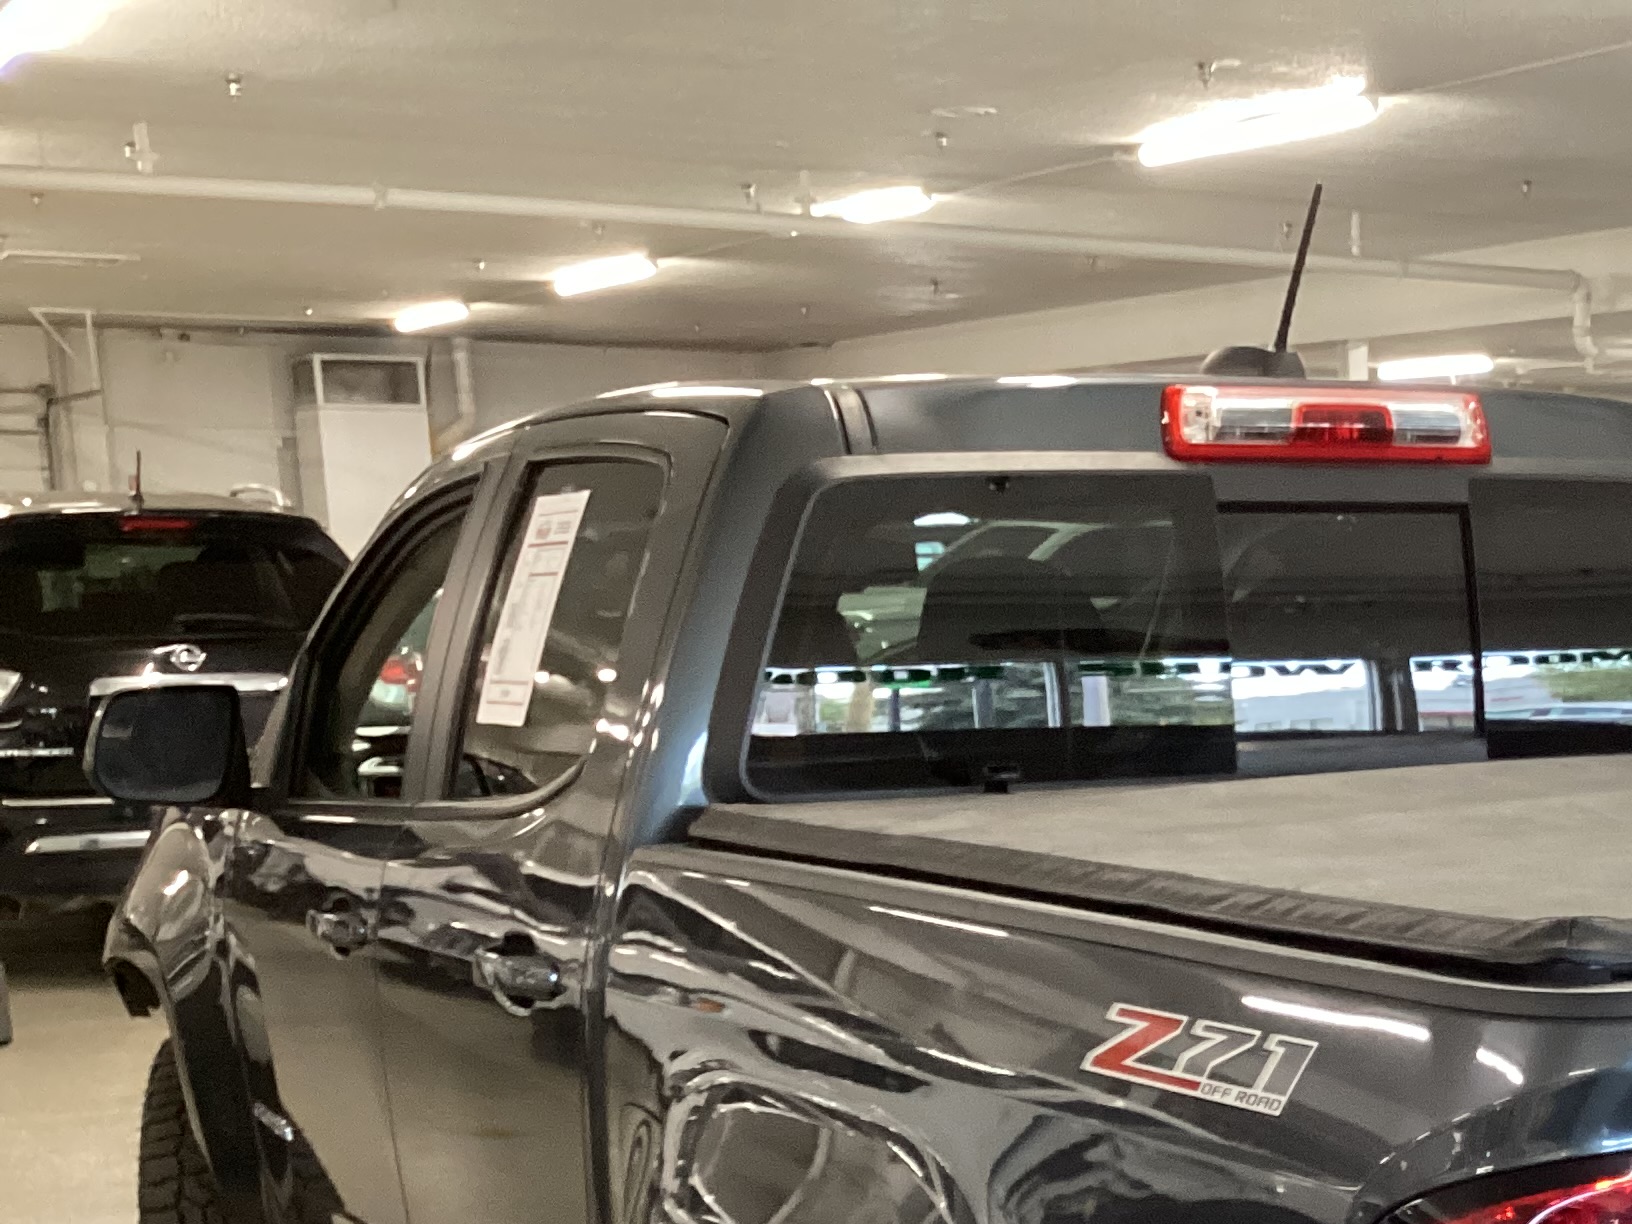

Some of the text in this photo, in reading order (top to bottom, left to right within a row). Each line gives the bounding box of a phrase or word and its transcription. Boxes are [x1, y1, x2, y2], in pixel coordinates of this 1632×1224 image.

[1080, 1002, 1319, 1100] Z71
[1200, 1083, 1283, 1112] OFF ROAD
